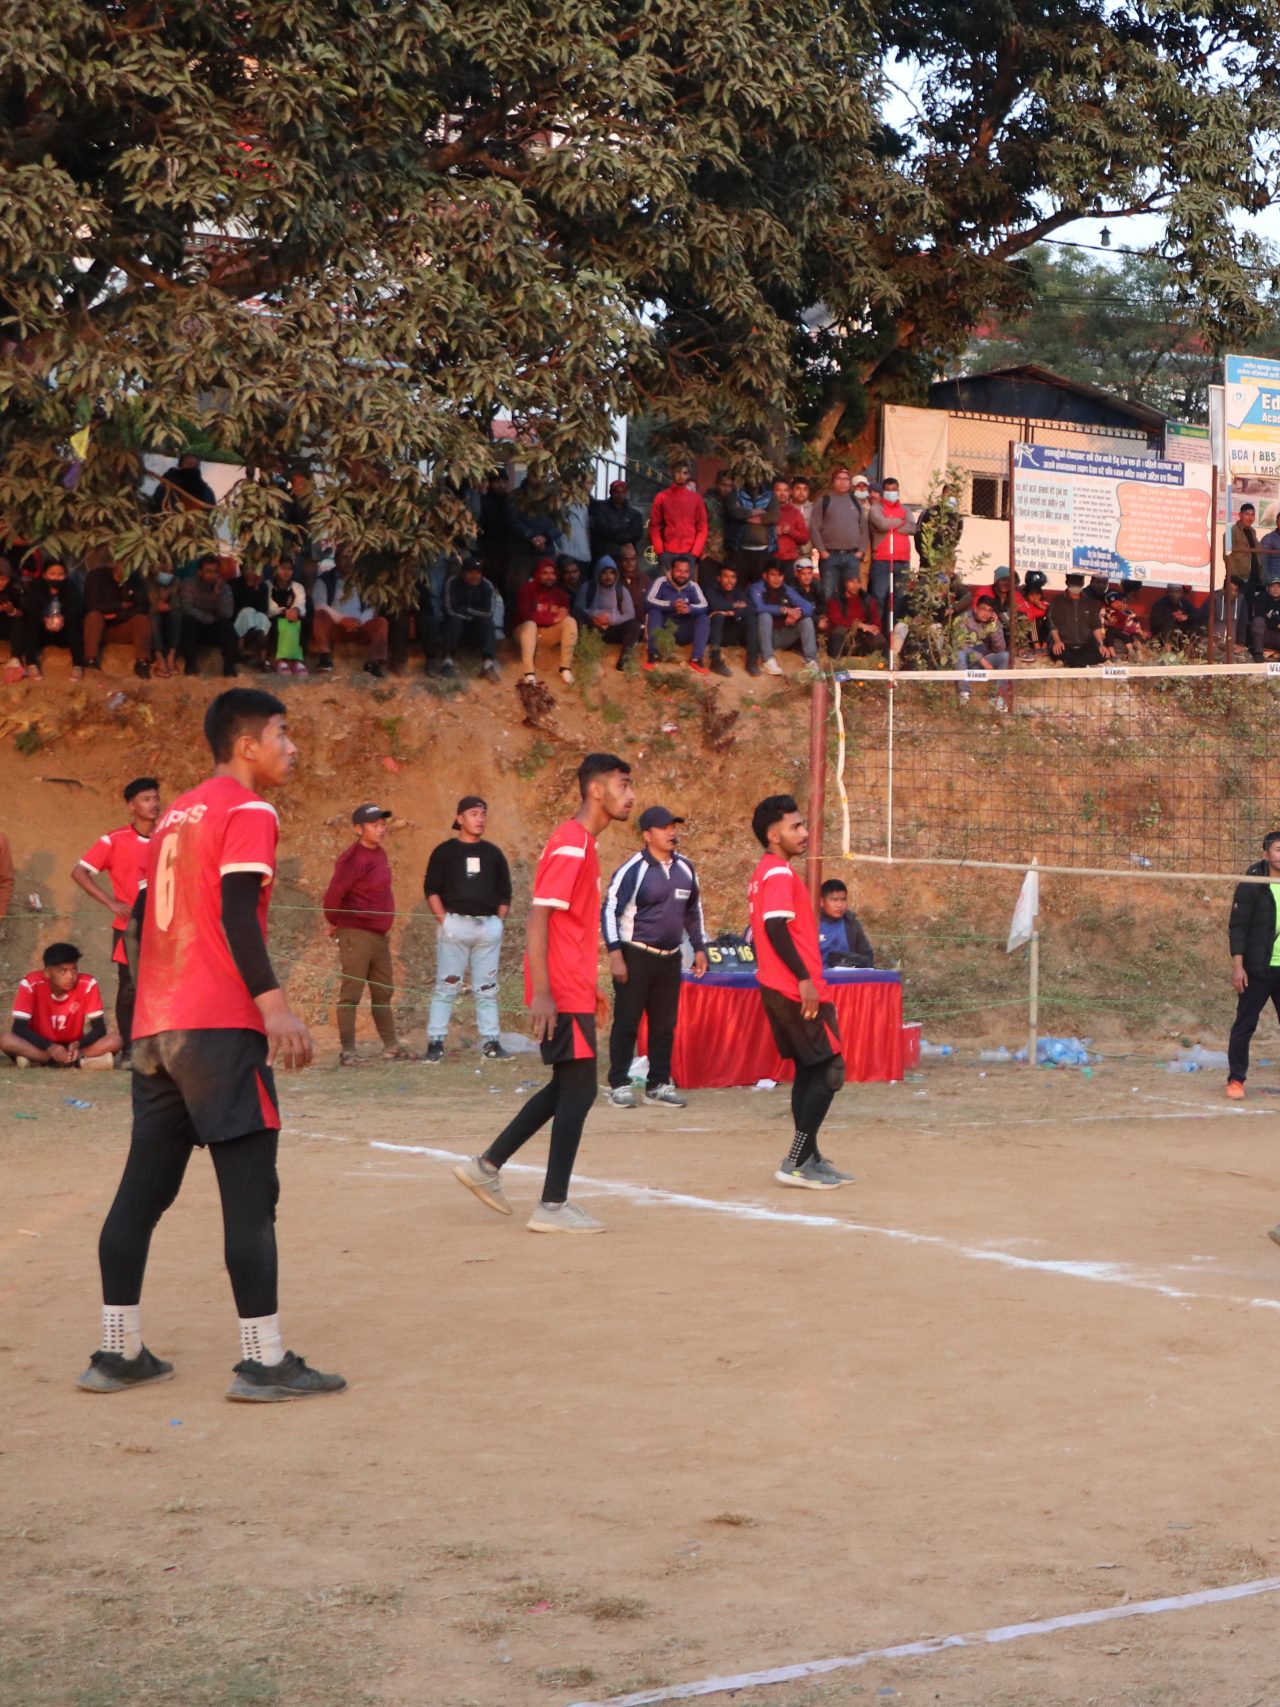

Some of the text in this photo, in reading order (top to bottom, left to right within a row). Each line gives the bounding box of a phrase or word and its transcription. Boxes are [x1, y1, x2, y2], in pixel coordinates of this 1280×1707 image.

[1231, 449, 1276, 462] BCA BBS
[155, 833, 178, 932] 6
[708, 946, 722, 963] 5
[738, 945, 755, 962] 16
